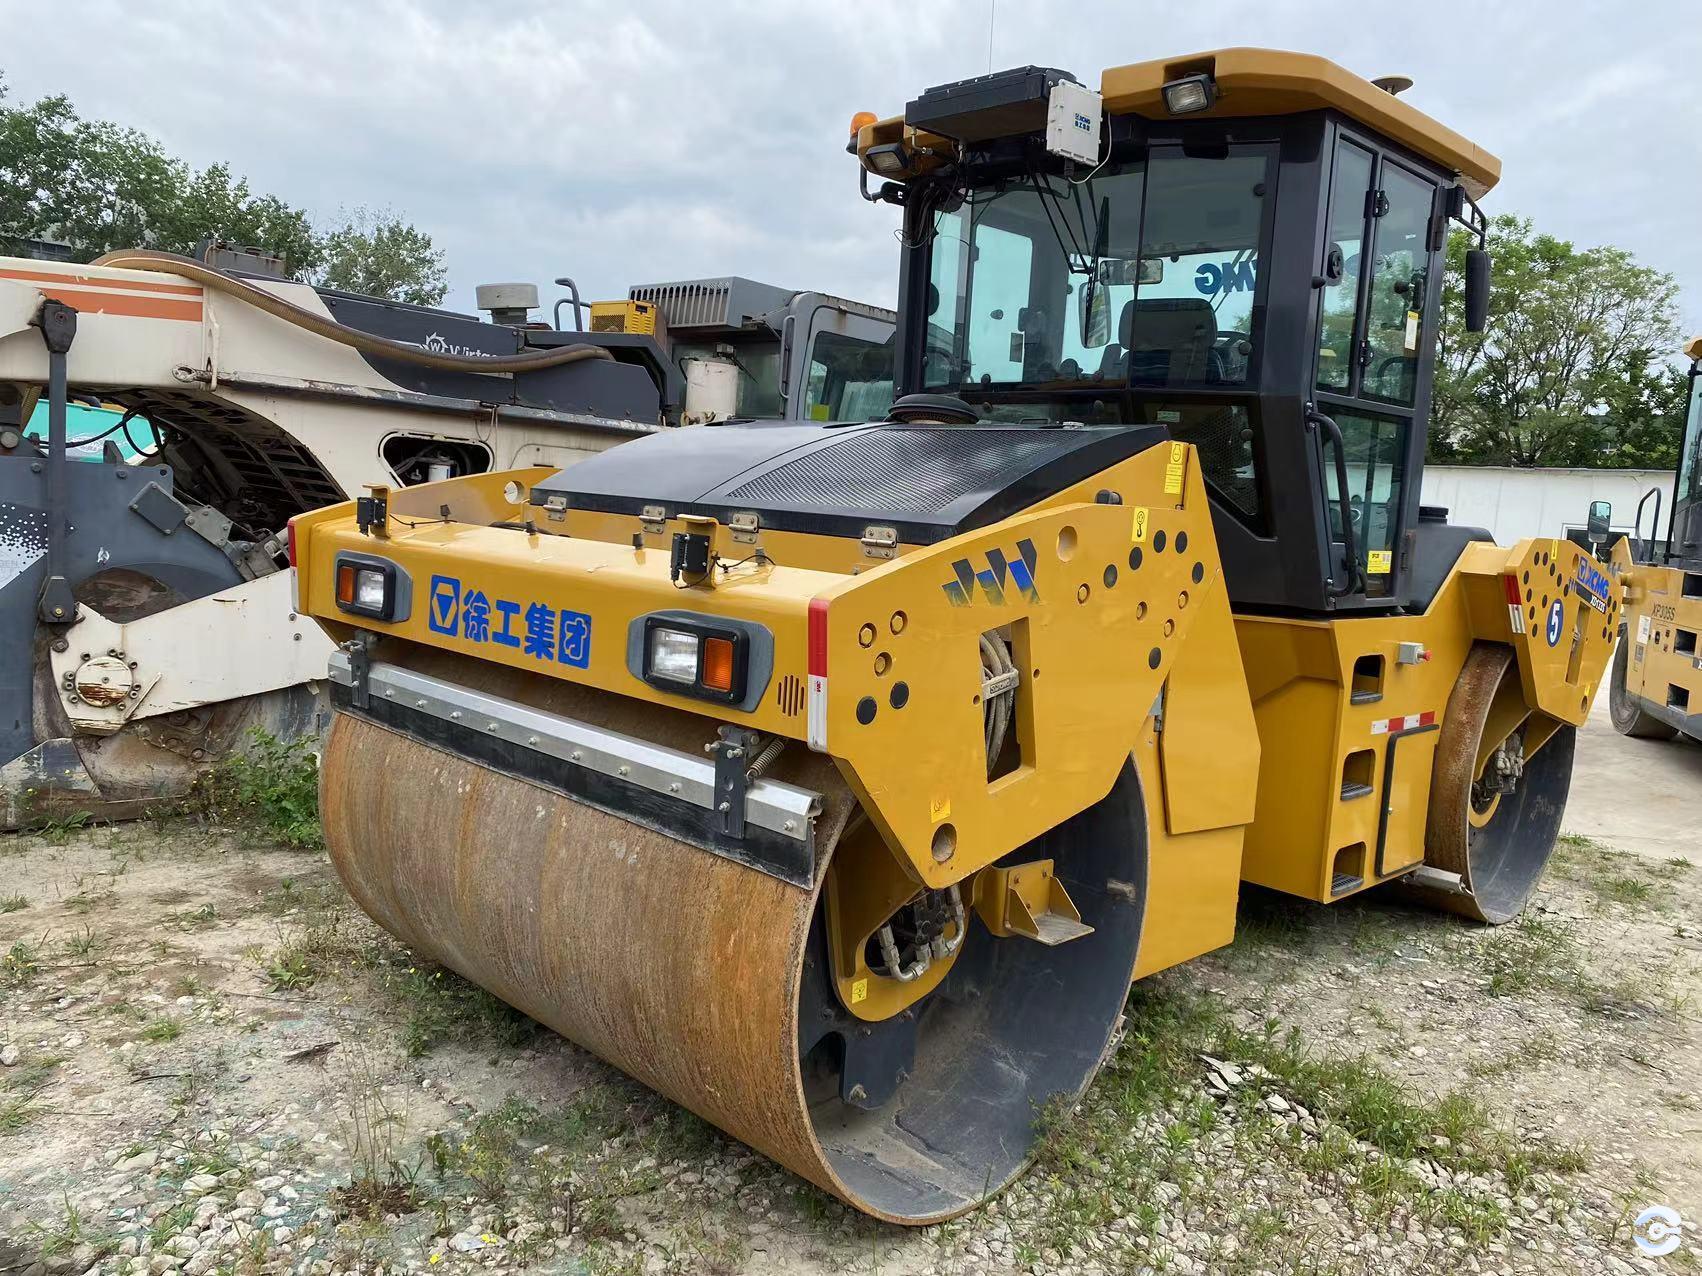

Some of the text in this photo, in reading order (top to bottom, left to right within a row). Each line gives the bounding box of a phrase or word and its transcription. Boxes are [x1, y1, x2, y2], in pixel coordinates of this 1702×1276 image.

[1587, 566, 1609, 600] XCMG
[463, 589, 592, 669] 徐工集团
[1550, 602, 1561, 644] 5
